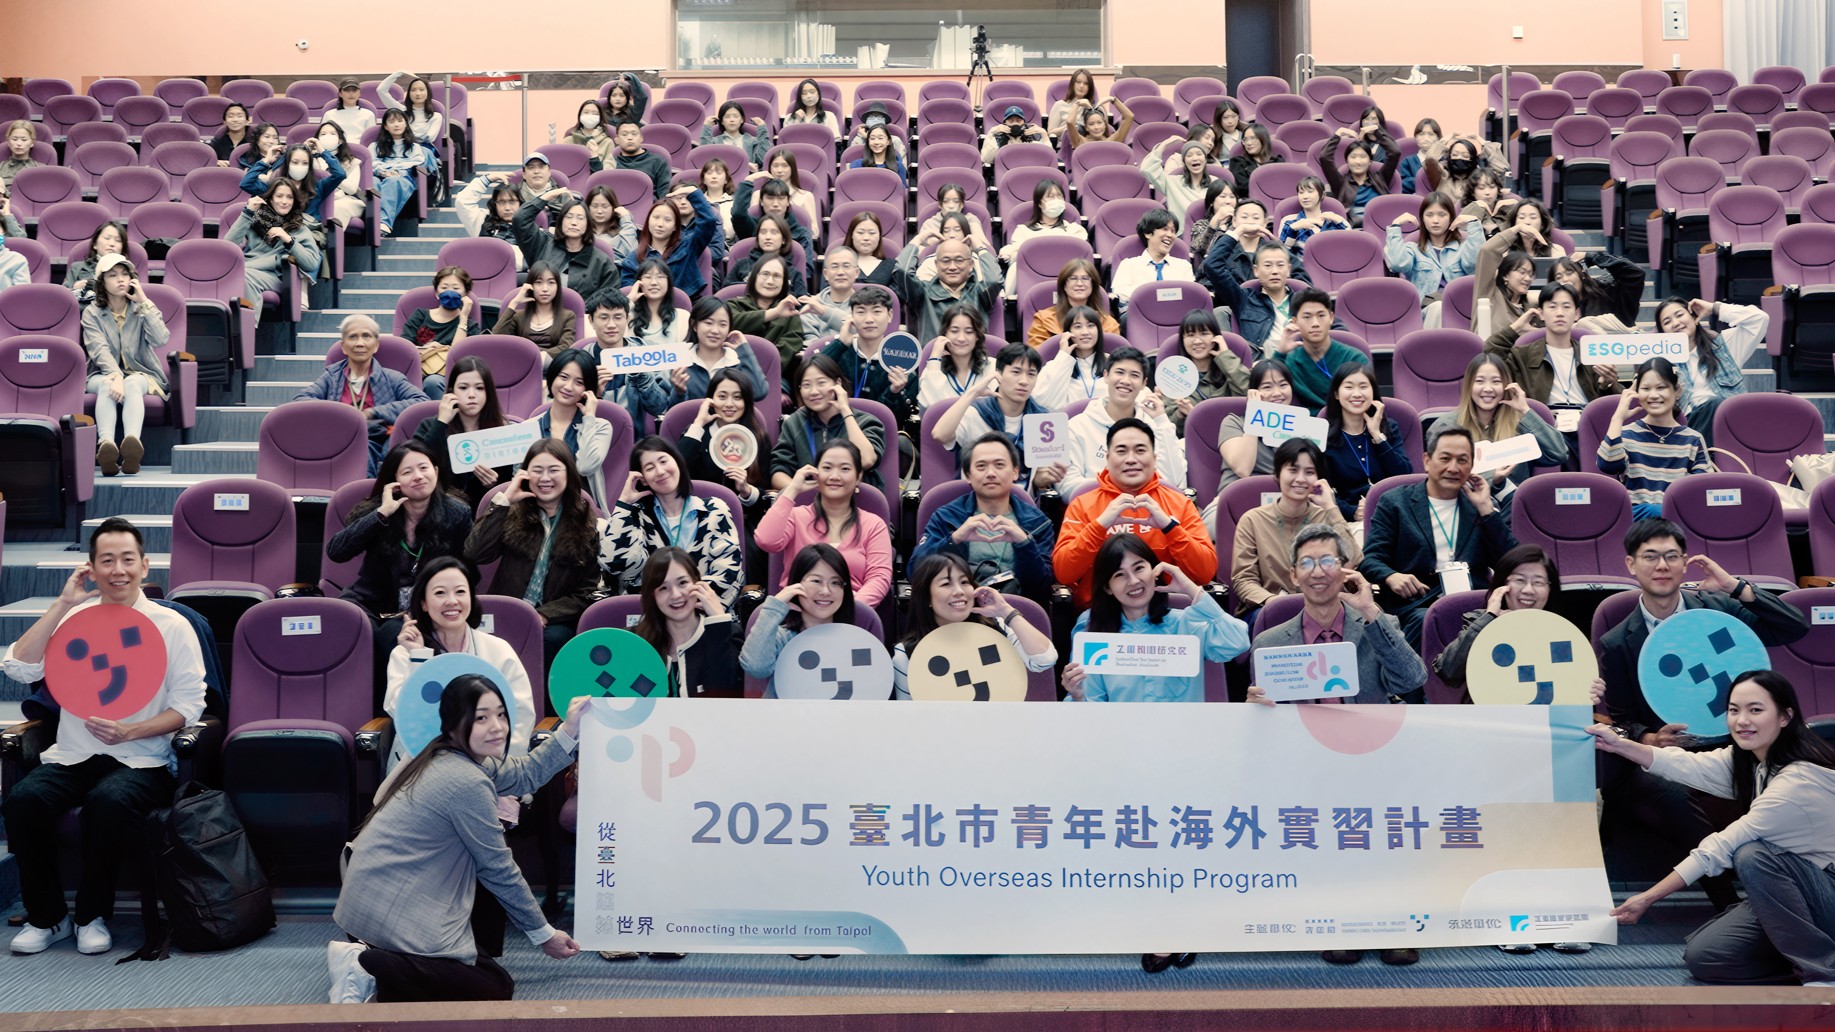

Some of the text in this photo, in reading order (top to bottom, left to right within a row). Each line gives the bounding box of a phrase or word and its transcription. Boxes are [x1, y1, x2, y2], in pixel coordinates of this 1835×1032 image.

[612, 350, 677, 367] Taboola
[1250, 409, 1296, 431] ADE
[691, 801, 1485, 850] 2025 臺北市青年赴海外實習計畫
[862, 865, 1298, 893] Youth Overseas Internship Program
[739, 924, 759, 935] the
[763, 924, 797, 935] world
[804, 925, 832, 936] from
